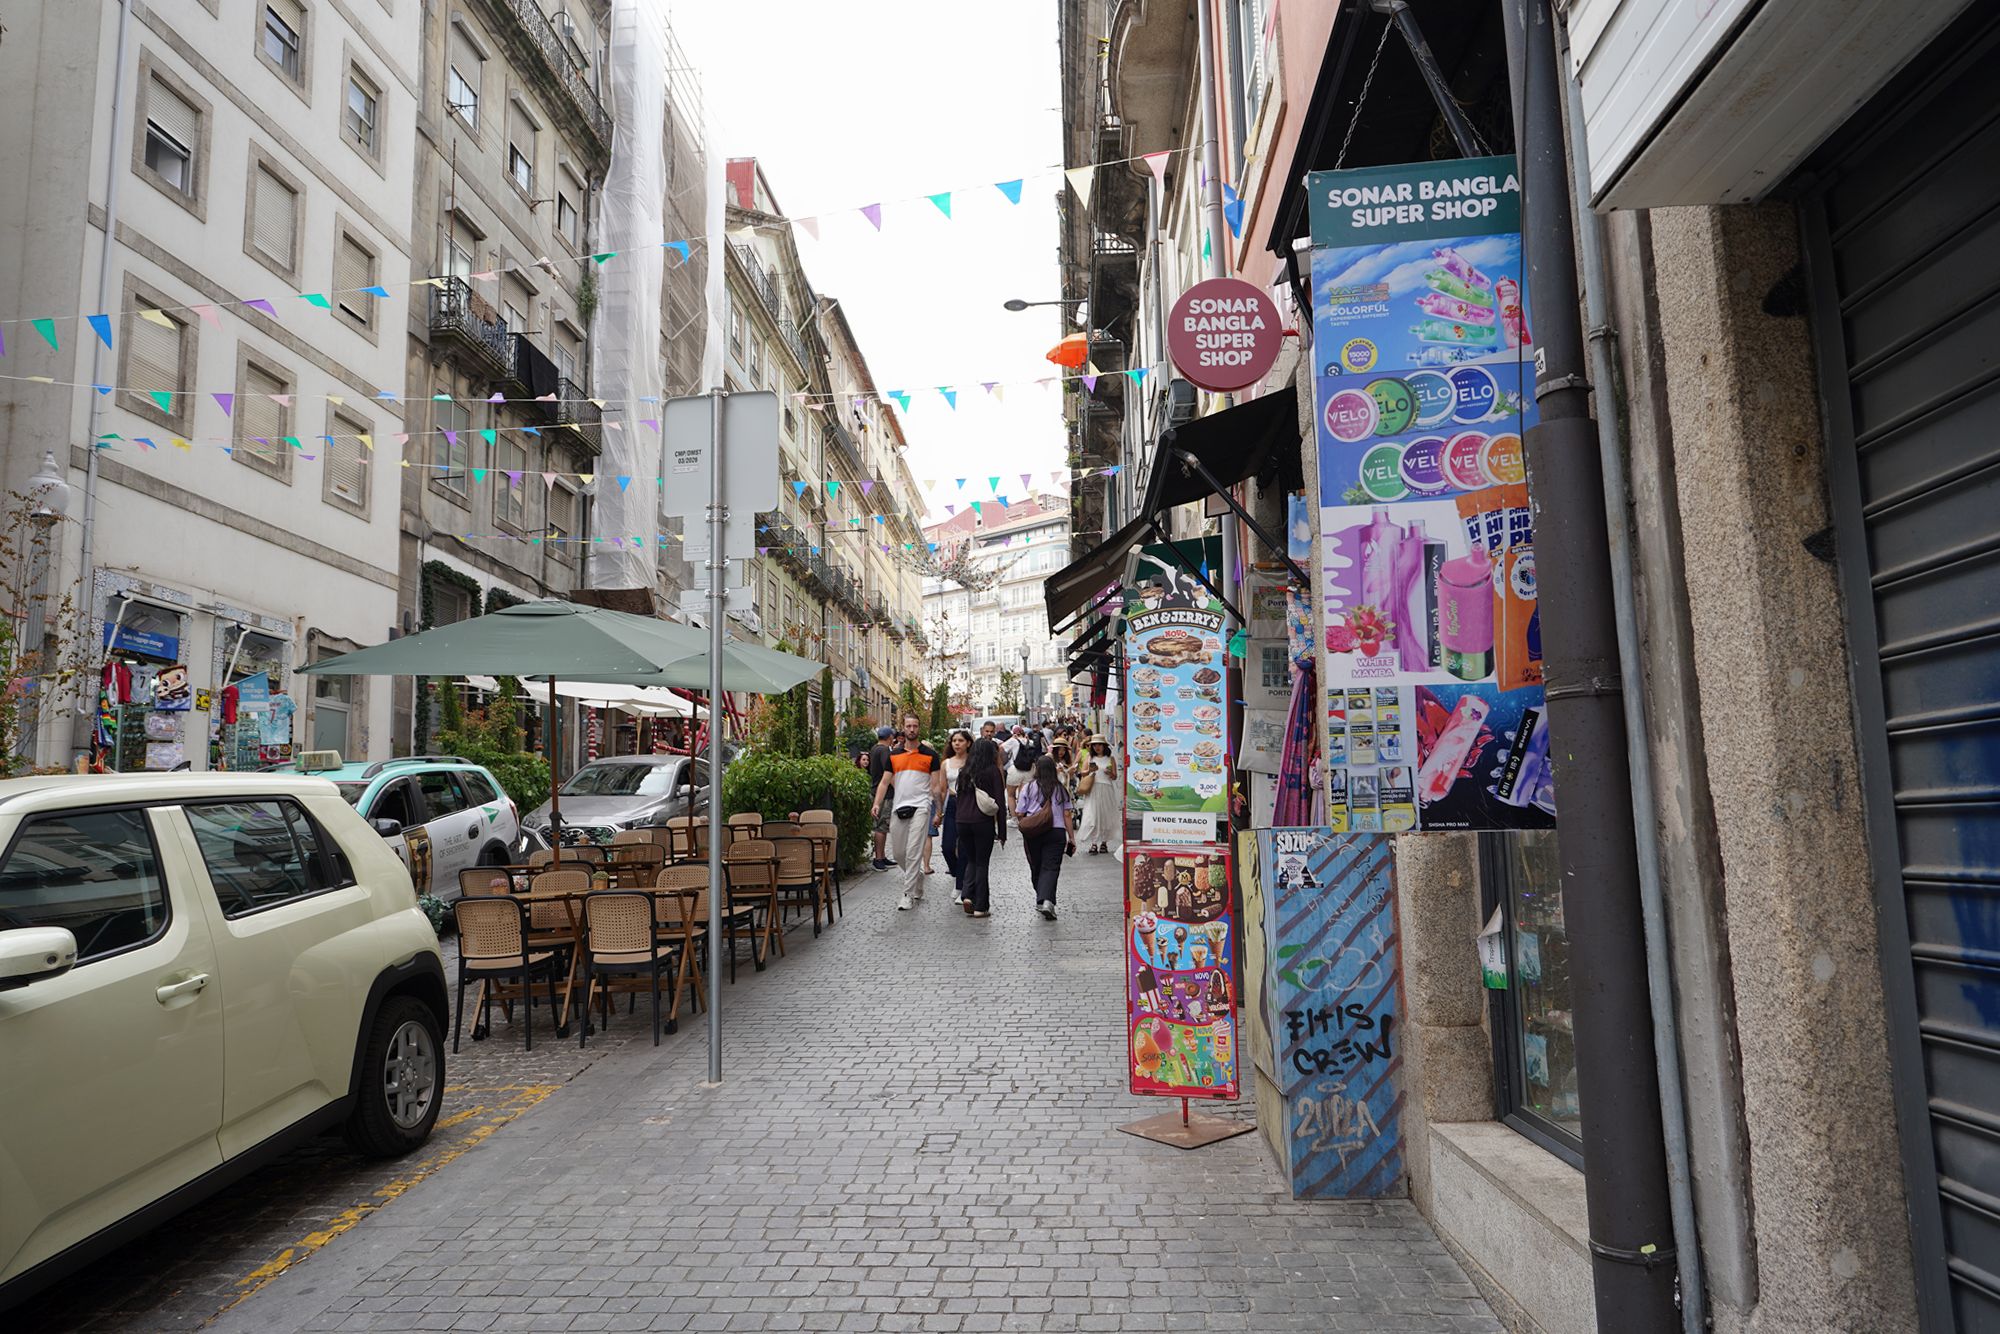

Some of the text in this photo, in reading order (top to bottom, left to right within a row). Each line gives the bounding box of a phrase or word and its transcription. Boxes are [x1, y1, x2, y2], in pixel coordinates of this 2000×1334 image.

[1327, 174, 1520, 208] SONAR BANGLA
[1351, 198, 1498, 228] SUPER SHOP
[1189, 298, 1259, 314] SONAR
[1329, 304, 1389, 316] COLORFUL
[1184, 315, 1265, 332] BANGLA
[1195, 333, 1255, 349] SUPER
[1200, 351, 1253, 366] SHOP
[1417, 387, 1451, 402] ELO
[1457, 385, 1493, 402] ELO
[1378, 397, 1408, 415] ELO
[1328, 407, 1369, 423] VELO
[1404, 455, 1438, 470] VEL
[1488, 453, 1520, 467] VEL
[1364, 466, 1398, 481] VEL
[1509, 507, 1530, 517] PRE
[1509, 529, 1534, 548] PE
[1165, 630, 1187, 638] NOVO
[1356, 656, 1395, 668] WHITE
[1351, 667, 1395, 679] MAMBA
[140, 676, 146, 689] 7
[1194, 972, 1210, 980] NOVO
[1293, 1014, 1393, 1076] CREW
